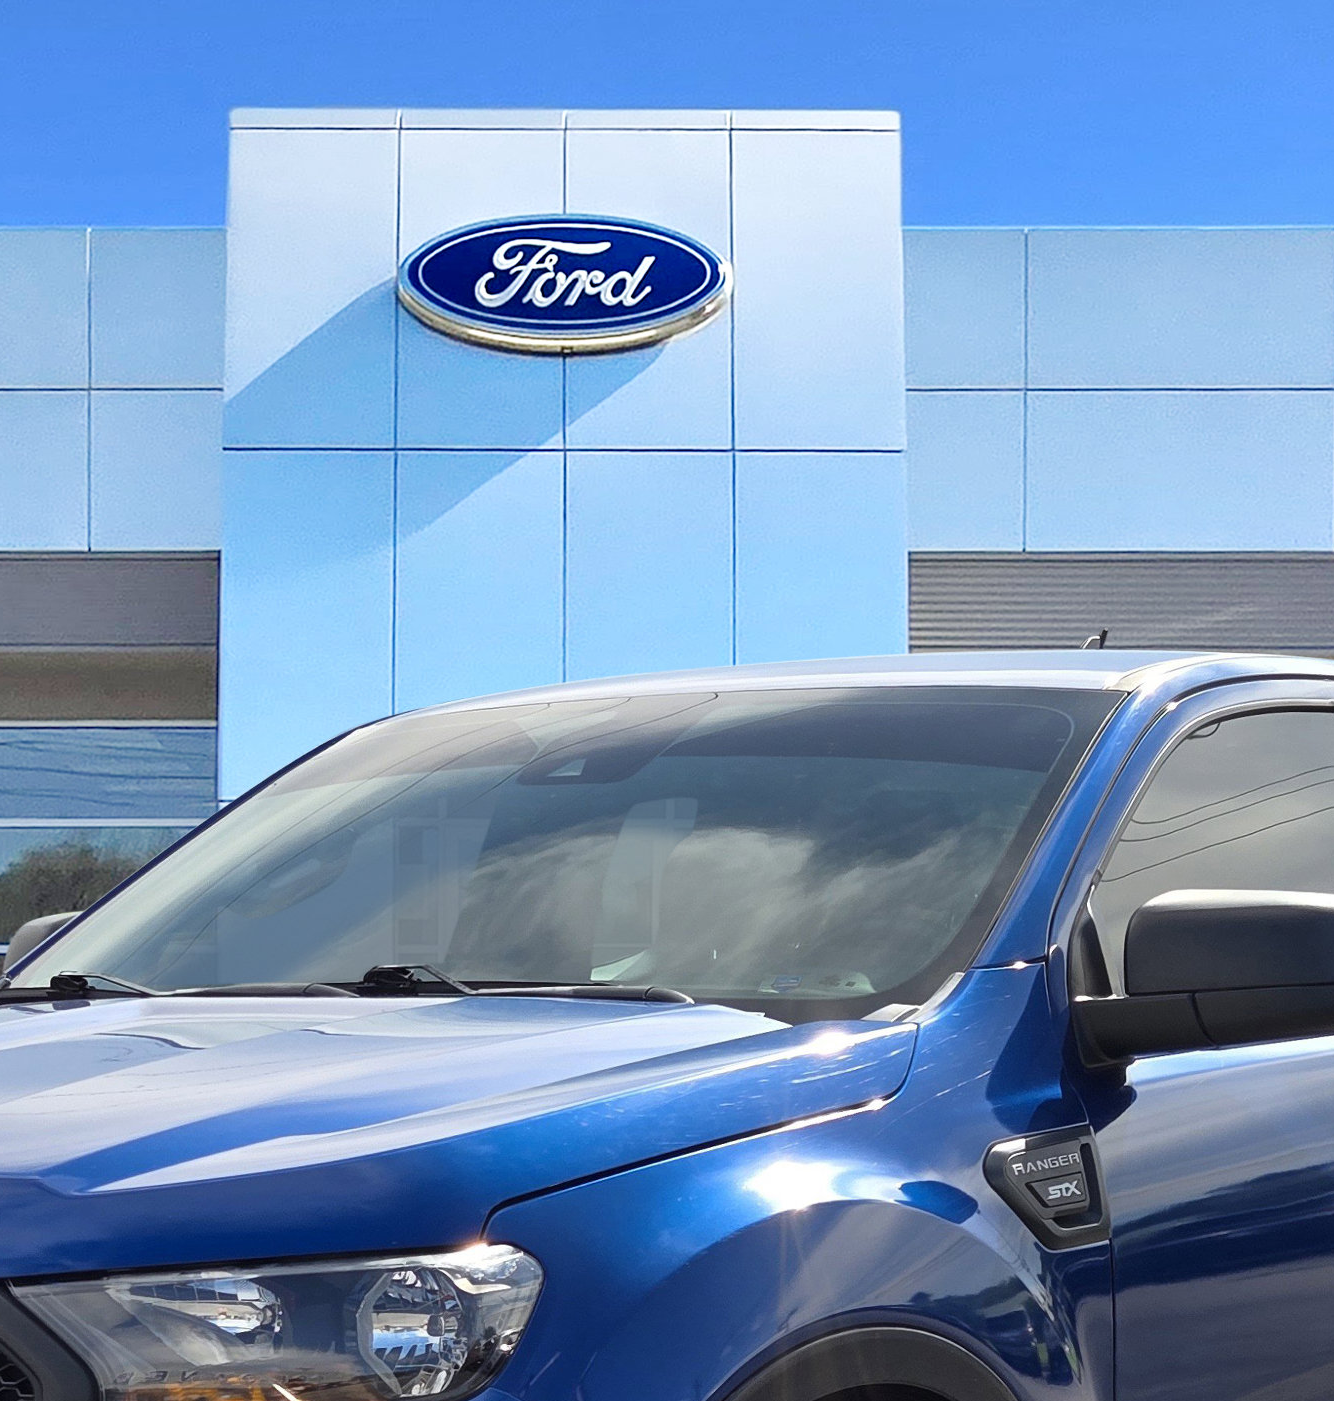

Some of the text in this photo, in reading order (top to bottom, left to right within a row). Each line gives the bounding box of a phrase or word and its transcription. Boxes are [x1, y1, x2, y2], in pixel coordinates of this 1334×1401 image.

[474, 237, 656, 308] Ford
[1013, 1152, 1080, 1175] RANGER
[1047, 1180, 1082, 1200] STX
